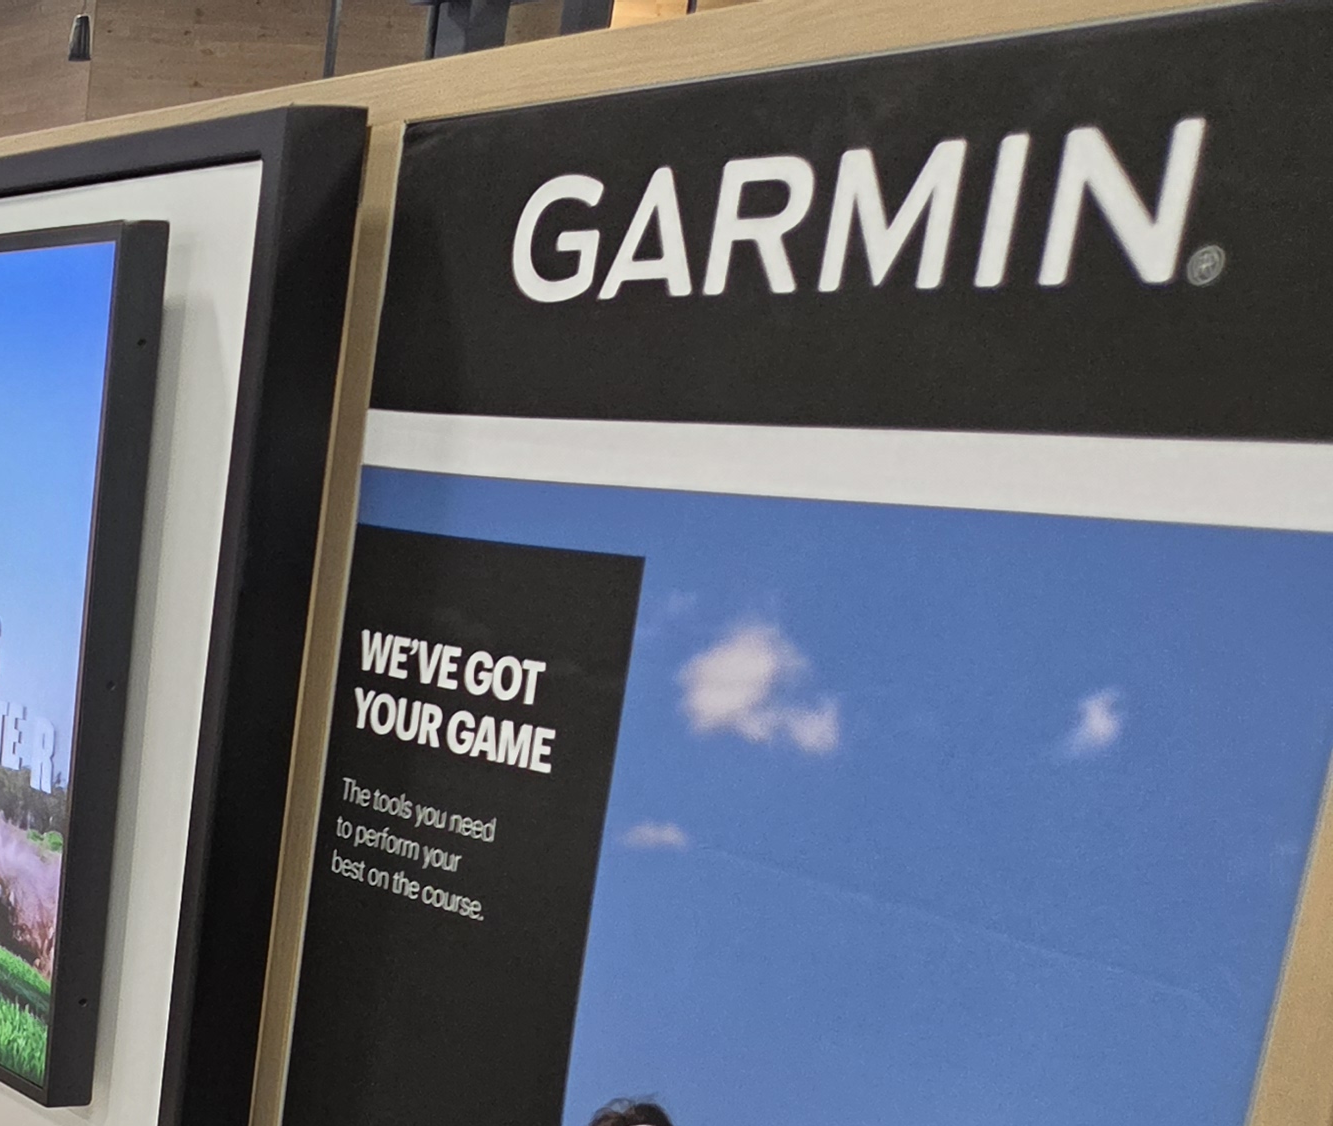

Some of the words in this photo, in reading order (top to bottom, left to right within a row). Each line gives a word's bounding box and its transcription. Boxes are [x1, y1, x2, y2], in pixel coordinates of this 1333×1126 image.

[361, 629, 462, 690] WE'VE
[464, 650, 546, 705] GOT
[354, 687, 443, 748] YOUR
[446, 710, 556, 774] GAME
[336, 816, 353, 838] to
[354, 825, 420, 860] perform
[422, 845, 462, 873] your
[342, 777, 369, 806] The
[373, 789, 413, 820] tools
[415, 802, 446, 829] you
[449, 813, 497, 842] need
[332, 849, 365, 883] best
[367, 866, 389, 890] on
[392, 871, 420, 900] the
[422, 886, 484, 921] course.
